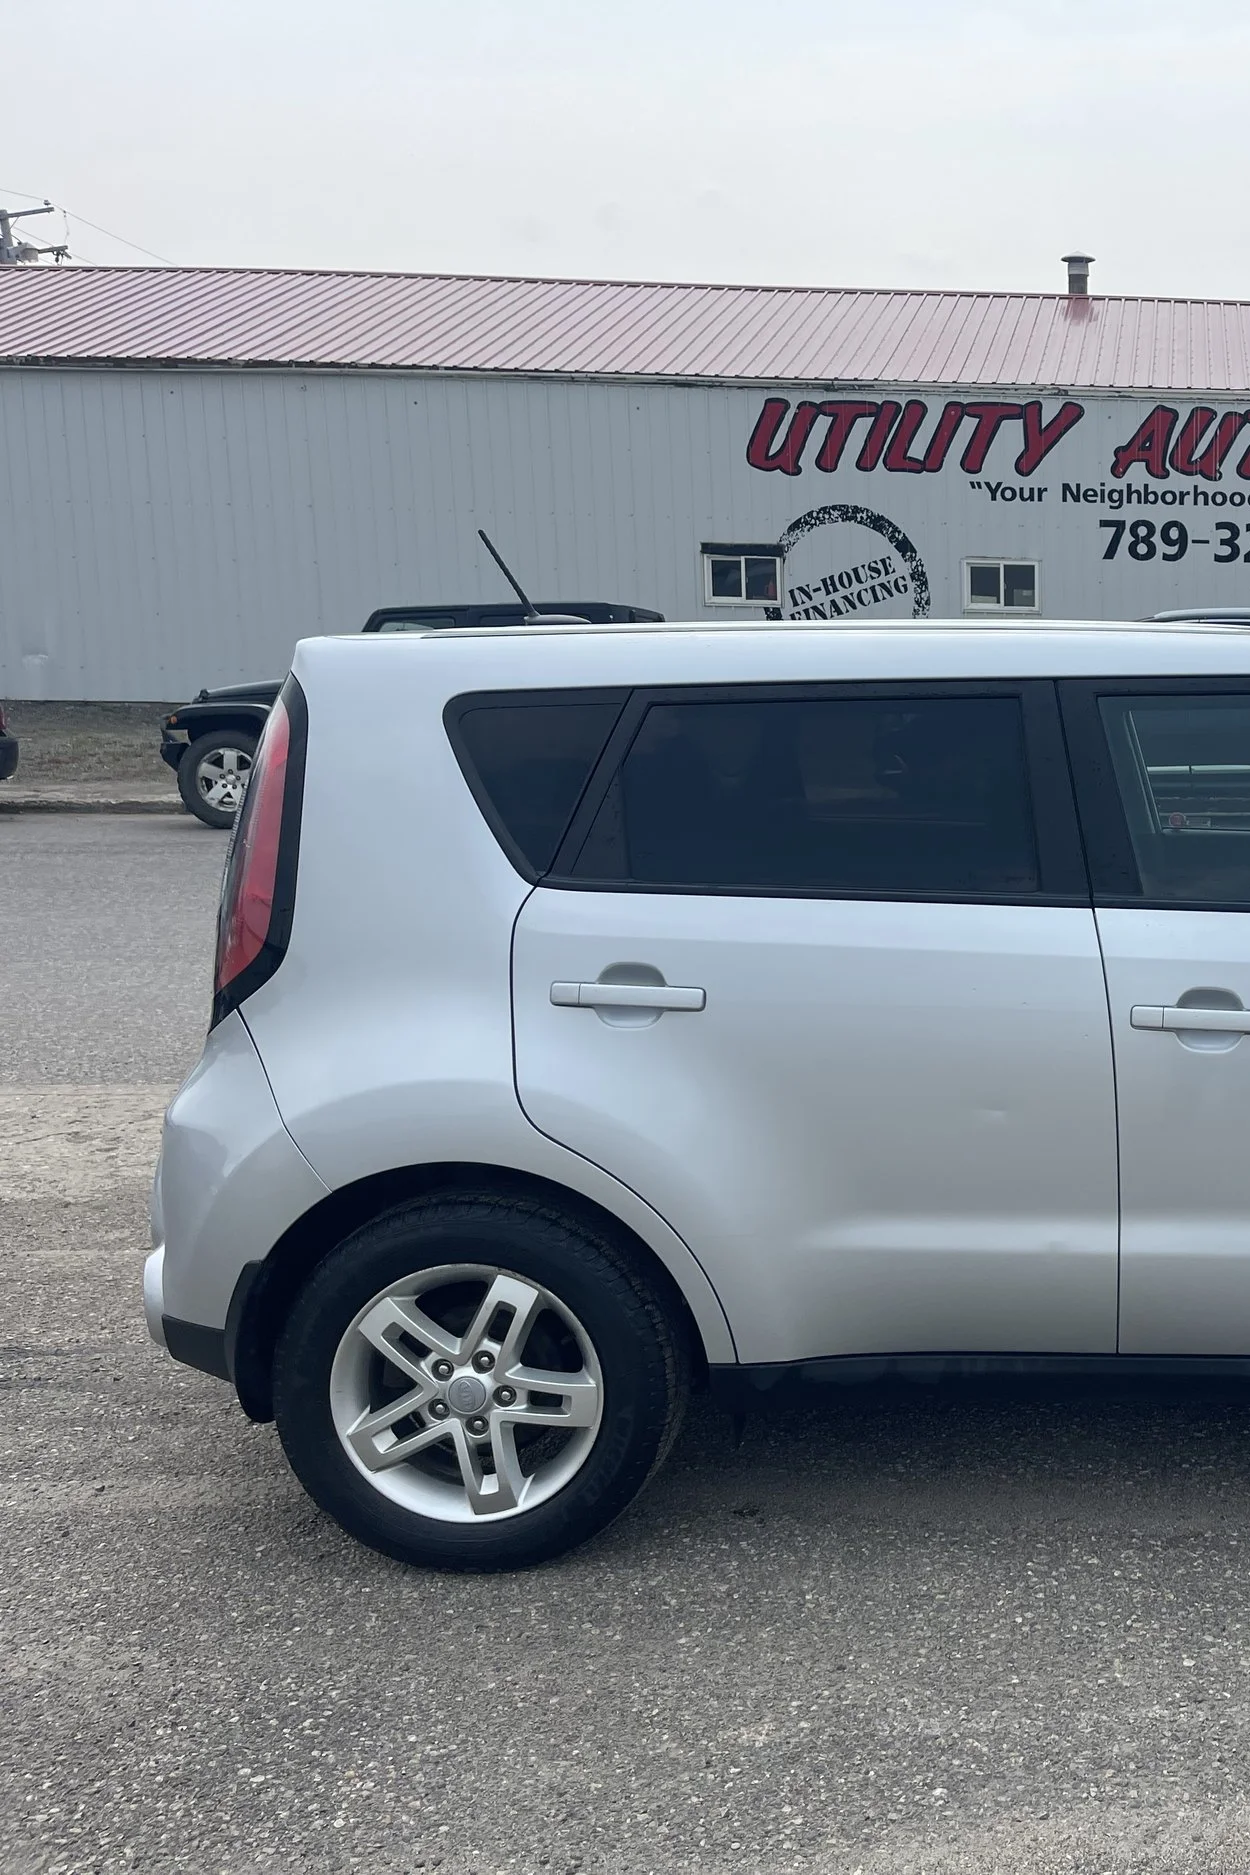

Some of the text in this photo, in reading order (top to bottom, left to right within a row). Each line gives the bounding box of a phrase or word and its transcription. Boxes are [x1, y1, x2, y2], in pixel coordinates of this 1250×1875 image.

[746, 398, 1085, 477] UTILITY
[969, 480, 1047, 503] "Your
[788, 556, 896, 607] IN-HOUSE
